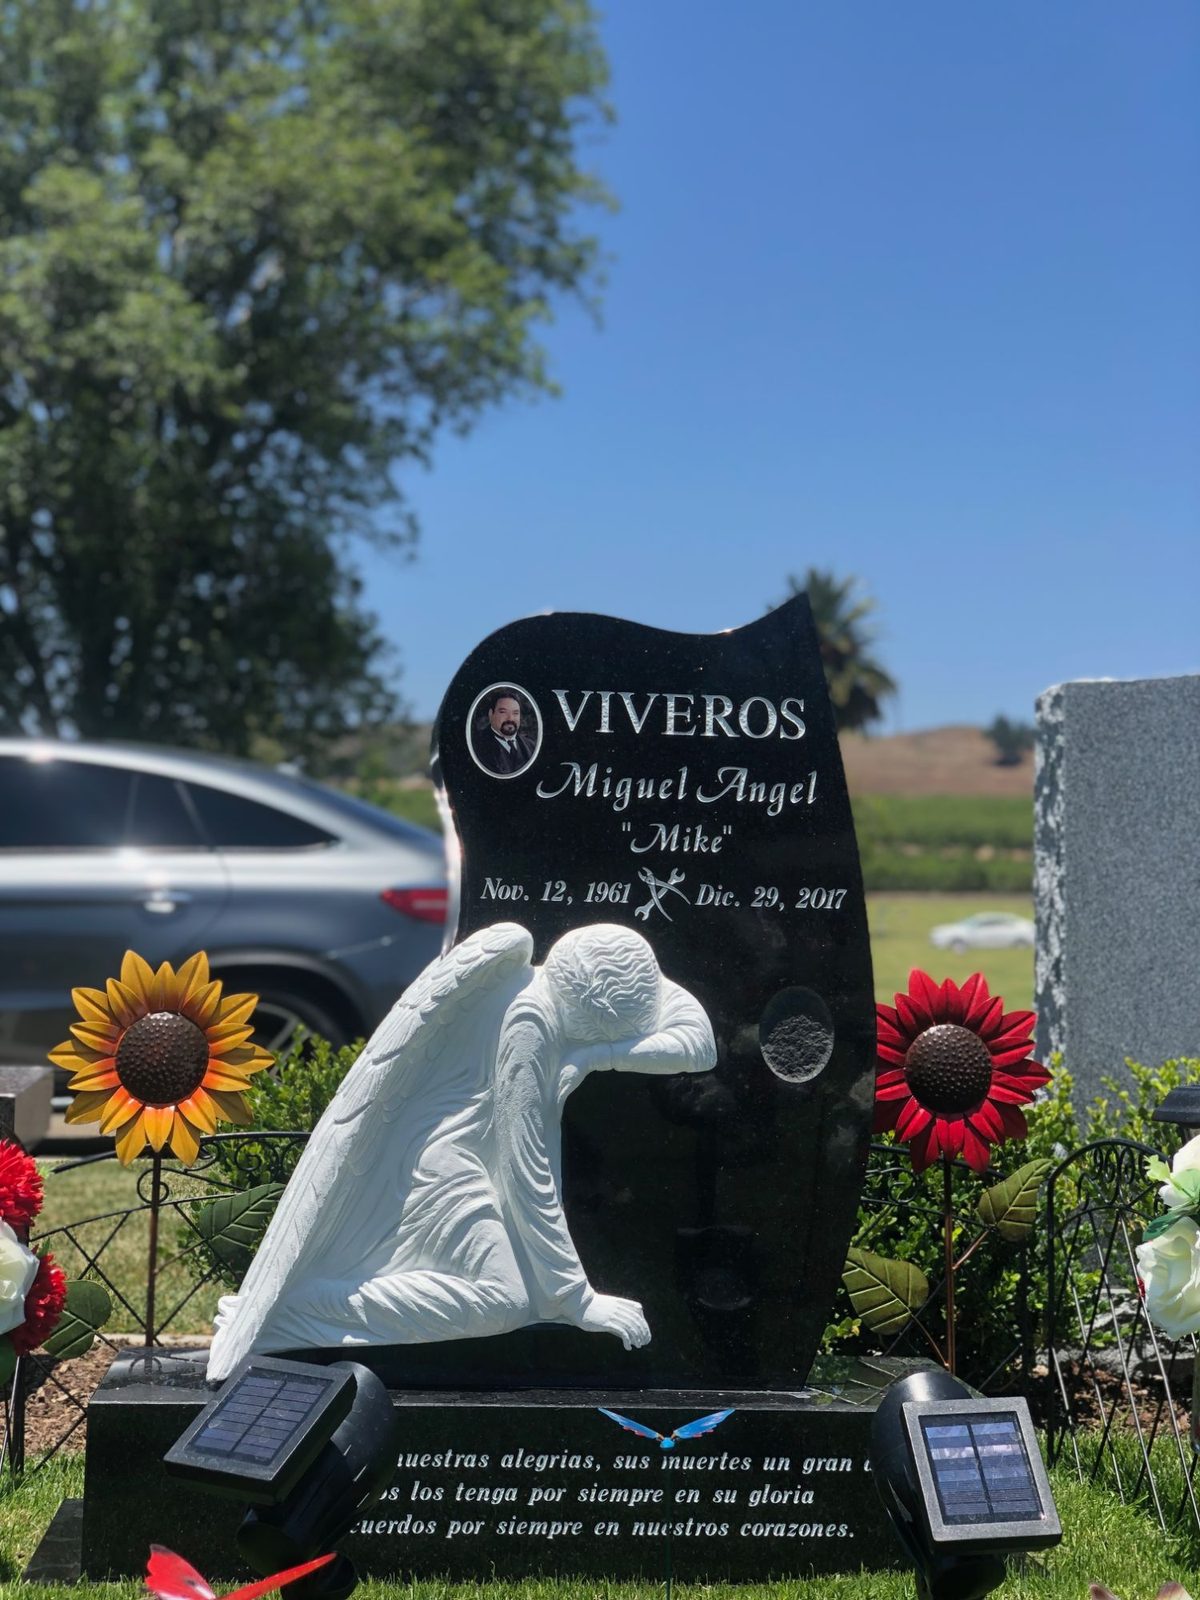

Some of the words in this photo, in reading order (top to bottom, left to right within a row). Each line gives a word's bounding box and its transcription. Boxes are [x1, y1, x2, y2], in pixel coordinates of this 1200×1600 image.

[552, 690, 807, 740] VIVEROS
[536, 761, 688, 812] Miguel
[695, 766, 818, 816] Angel
[621, 821, 732, 854] "Mike"
[480, 877, 530, 901] Nov.
[540, 880, 573, 905] 12,
[583, 882, 631, 904] 1961
[694, 884, 740, 907] Dic.
[751, 886, 785, 911] 29,
[797, 887, 848, 910] 2017
[500, 1447, 601, 1472] alegrias,
[613, 1455, 650, 1470] sus
[660, 1452, 752, 1470] muertes
[763, 1457, 790, 1471] un
[802, 1457, 852, 1475] gran
[410, 1480, 445, 1501] los
[455, 1482, 518, 1505] tenga
[527, 1487, 567, 1506] por
[577, 1482, 664, 1507] siempre
[674, 1489, 700, 1504] en
[712, 1489, 738, 1504] su
[748, 1483, 815, 1508] gloria
[445, 1520, 486, 1539] por
[495, 1515, 583, 1540] siempre
[593, 1521, 620, 1536] en
[631, 1518, 730, 1537] nuestros
[740, 1522, 855, 1538] corazones.
